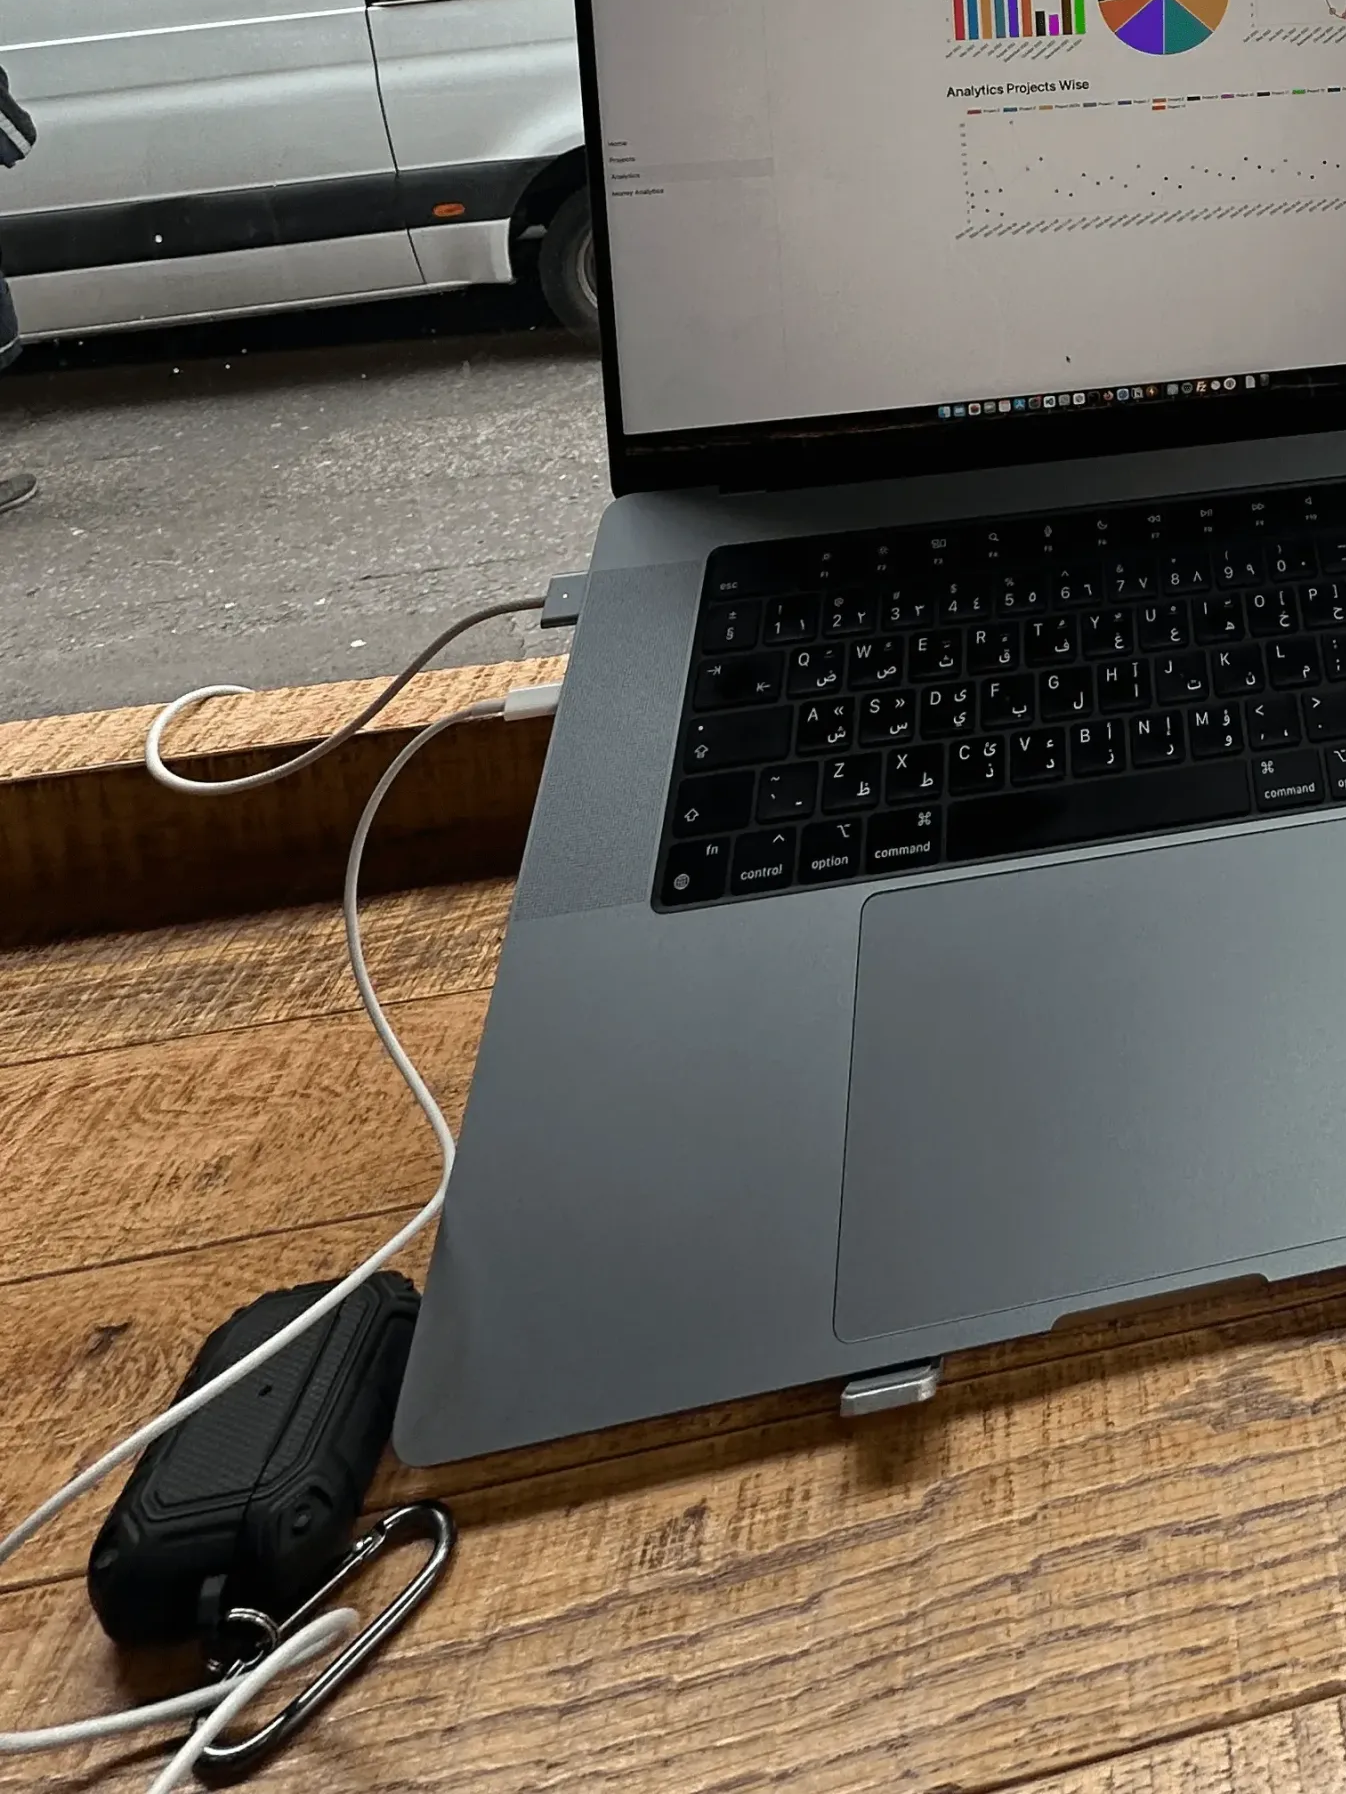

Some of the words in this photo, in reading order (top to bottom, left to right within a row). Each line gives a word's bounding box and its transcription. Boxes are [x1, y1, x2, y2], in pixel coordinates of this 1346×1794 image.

[946, 84, 1004, 98] Analytics
[1007, 80, 1056, 96] Projects
[1058, 79, 1090, 91] Wise
[1277, 560, 1286, 571] 0
[1171, 573, 1179, 585] 8
[1224, 567, 1233, 578] 9
[720, 582, 737, 590] esc
[1117, 580, 1124, 591] 7
[1061, 587, 1070, 598] 6
[1309, 589, 1317, 600] P
[948, 601, 957, 611] 4
[1005, 594, 1014, 606] 5
[1255, 595, 1264, 607] O
[891, 607, 899, 620] 3
[1146, 609, 1156, 621] U
[833, 615, 841, 627] 2
[1090, 616, 1099, 628] Y
[1034, 623, 1042, 636] T
[977, 631, 985, 643] R
[919, 638, 927, 651] E
[857, 645, 871, 658] W
[1276, 646, 1285, 658] L
[799, 653, 809, 666] Q
[1220, 653, 1230, 666] K
[1165, 661, 1172, 673] J
[1107, 668, 1117, 681] H
[1049, 676, 1059, 689] G
[991, 683, 999, 697] F
[930, 691, 941, 705] D
[870, 699, 880, 713] S
[808, 708, 818, 721] A
[1196, 712, 1208, 726] M
[1139, 720, 1149, 734] N
[1081, 729, 1090, 742] B
[1020, 737, 1030, 751] V
[959, 745, 970, 759] C
[897, 754, 907, 769] X
[834, 763, 844, 778] Z
[1265, 783, 1315, 799] command
[707, 845, 718, 855] fn
[875, 841, 930, 858] command
[812, 856, 848, 870] option
[741, 864, 782, 880] control
